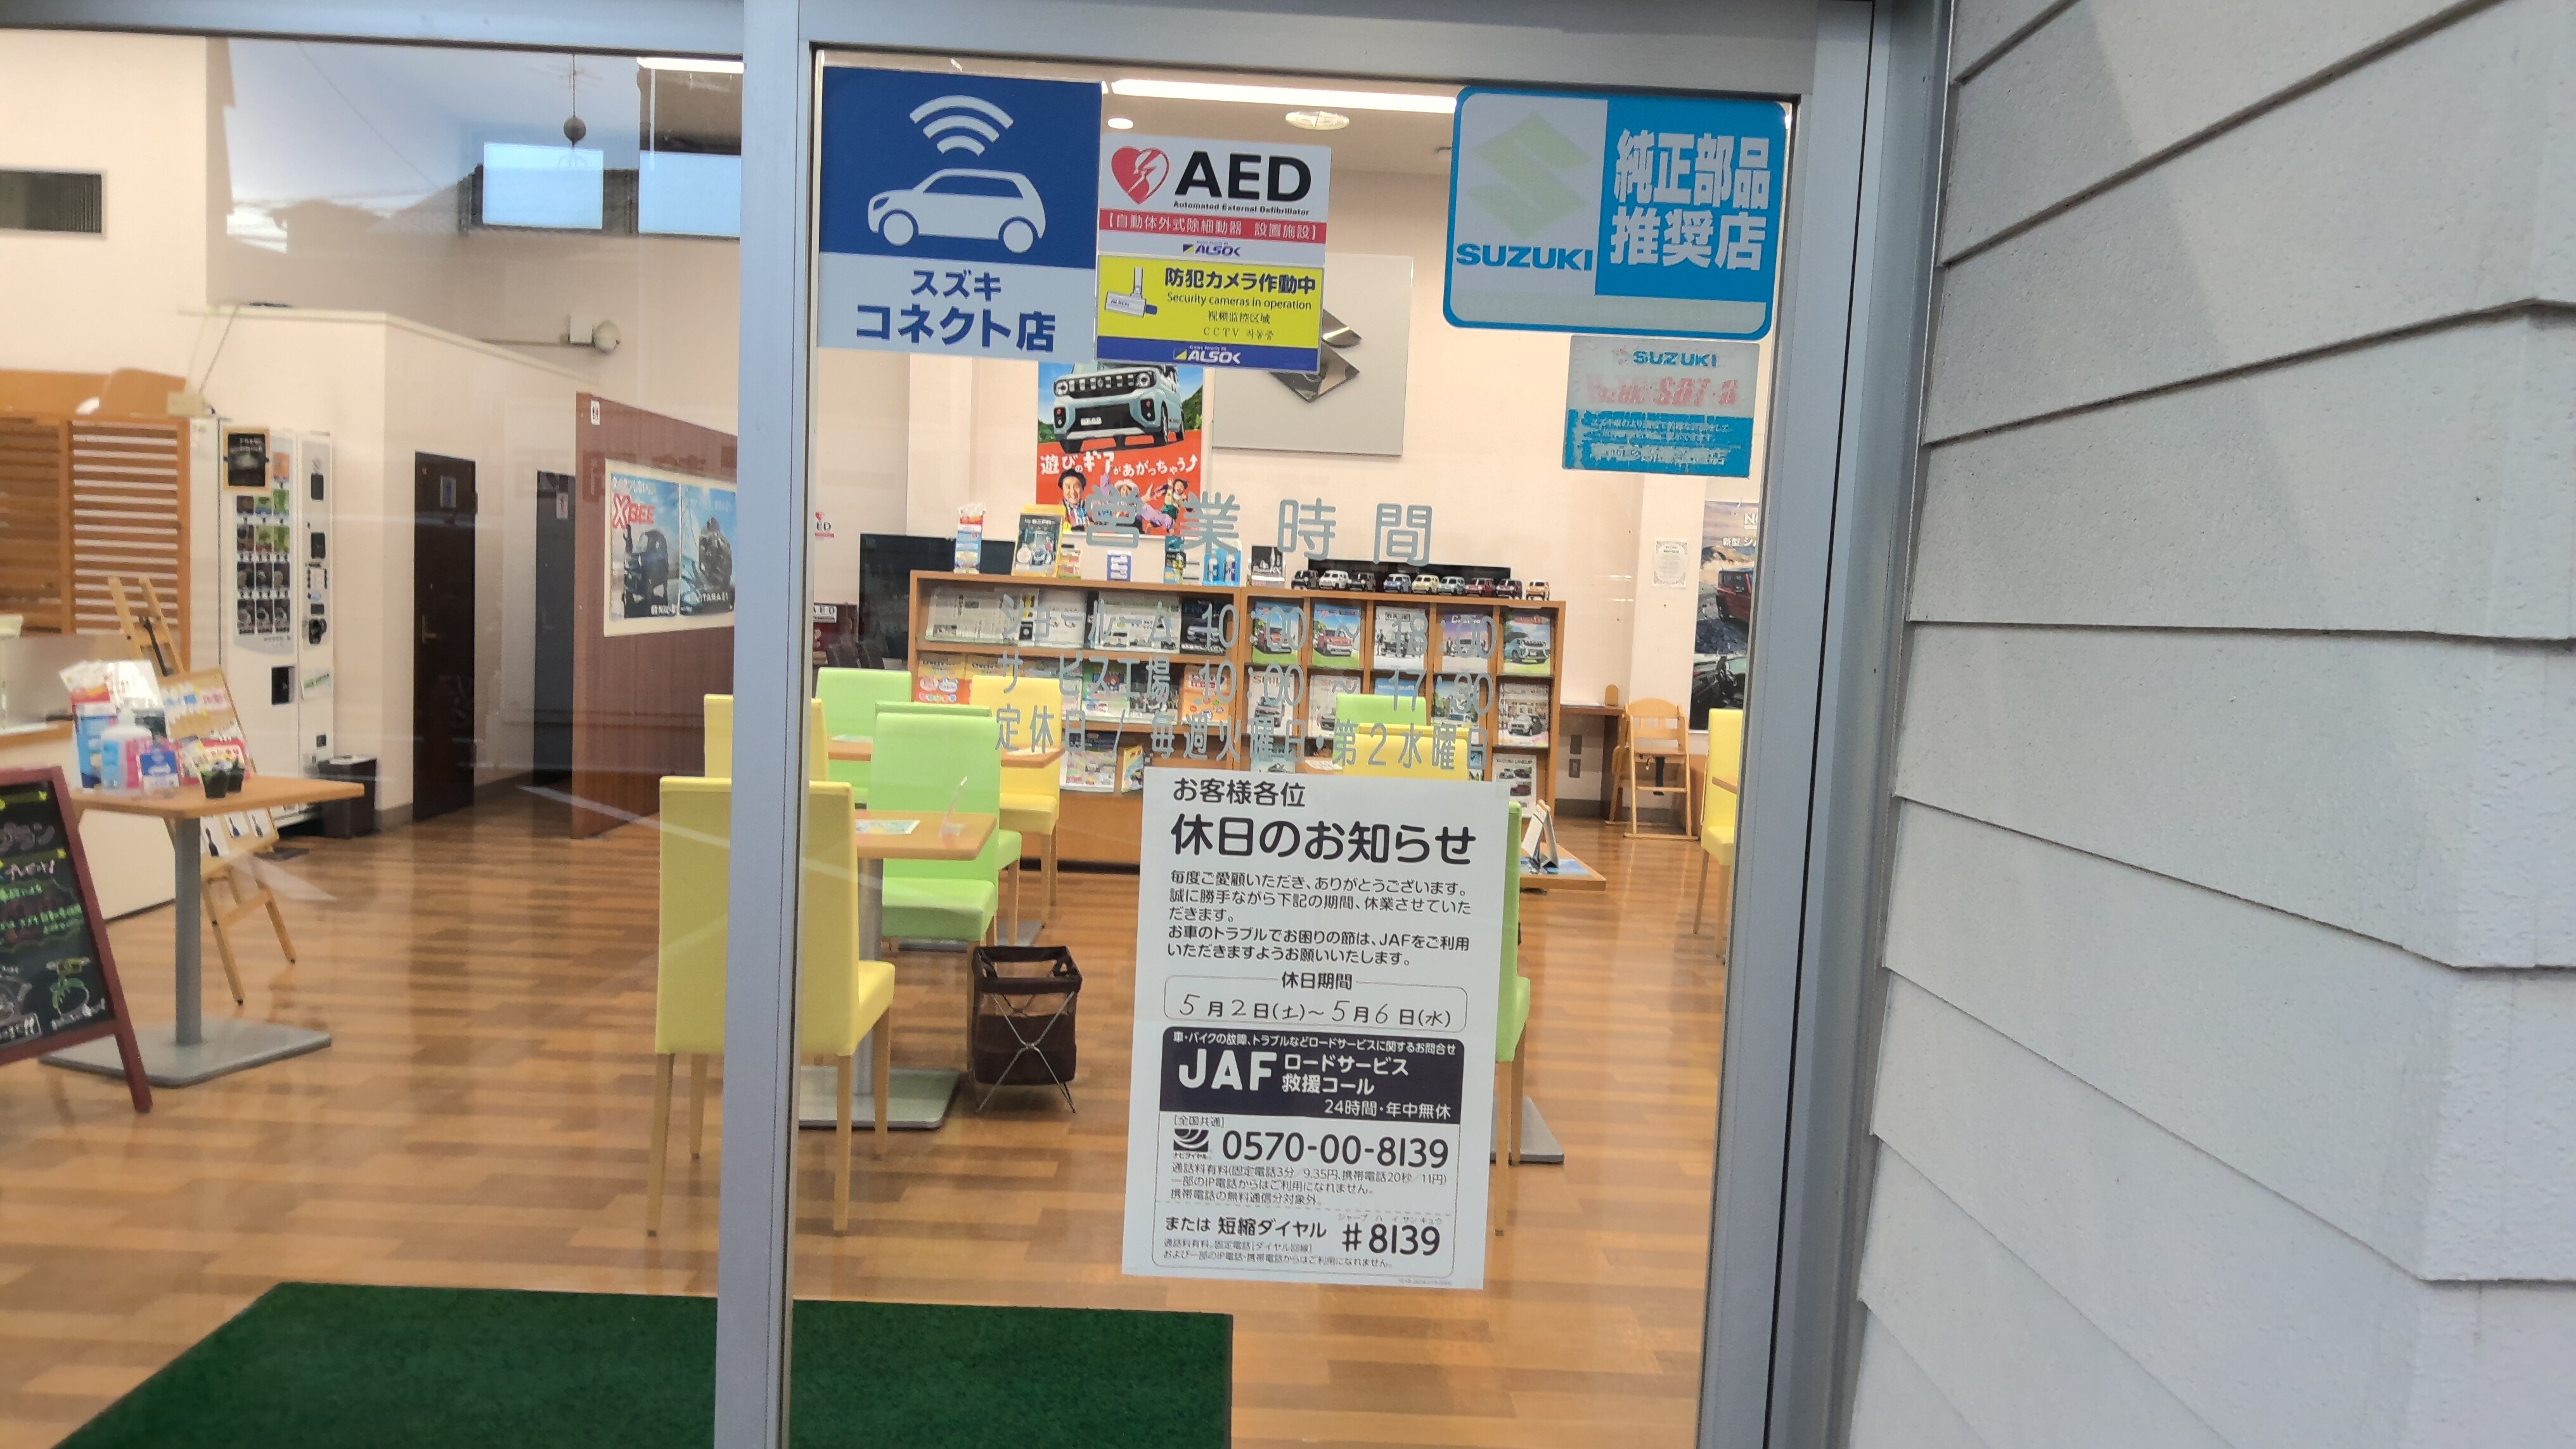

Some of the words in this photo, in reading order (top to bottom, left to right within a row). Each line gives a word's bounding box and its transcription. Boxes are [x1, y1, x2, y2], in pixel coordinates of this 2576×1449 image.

[1175, 150, 1311, 202] AED
[1613, 128, 1771, 209] 純正部品
[1173, 200, 1219, 210] Automated
[1222, 203, 1257, 213] External
[1260, 206, 1310, 216] Defibrillator
[1610, 207, 1767, 271] 推奨店
[1455, 242, 1594, 271] SUZUKI
[911, 269, 1001, 302] スズキ
[1164, 267, 1316, 294] 防犯カメラ作動中
[1168, 292, 1206, 306] Security
[1209, 296, 1249, 307] cameras
[1252, 298, 1261, 307] in
[1263, 299, 1311, 310] operation
[857, 303, 1055, 352] コネクト店
[1633, 351, 1718, 367] SUZUKI
[1085, 485, 1433, 566] 営業時間
[1173, 777, 1306, 808] お客様各位
[1170, 813, 1476, 865] 休日のお知らせ
[1169, 906, 1233, 922] だきます。
[1168, 943, 1410, 967] いただきますようお願いいたします。
[1280, 971, 1353, 991] 休日期間
[1178, 1048, 1277, 1092] JAF
[1284, 1053, 1409, 1076] ロードサービス
[1282, 1072, 1375, 1096] 救援コール
[1324, 1098, 1452, 1120] 24時間・年中無休
[1222, 1130, 1449, 1169] 0570-00-8139
[1166, 1216, 1211, 1232] または
[1218, 1216, 1327, 1238] 短縮ダイヤル
[1341, 1222, 1440, 1256] #8139
